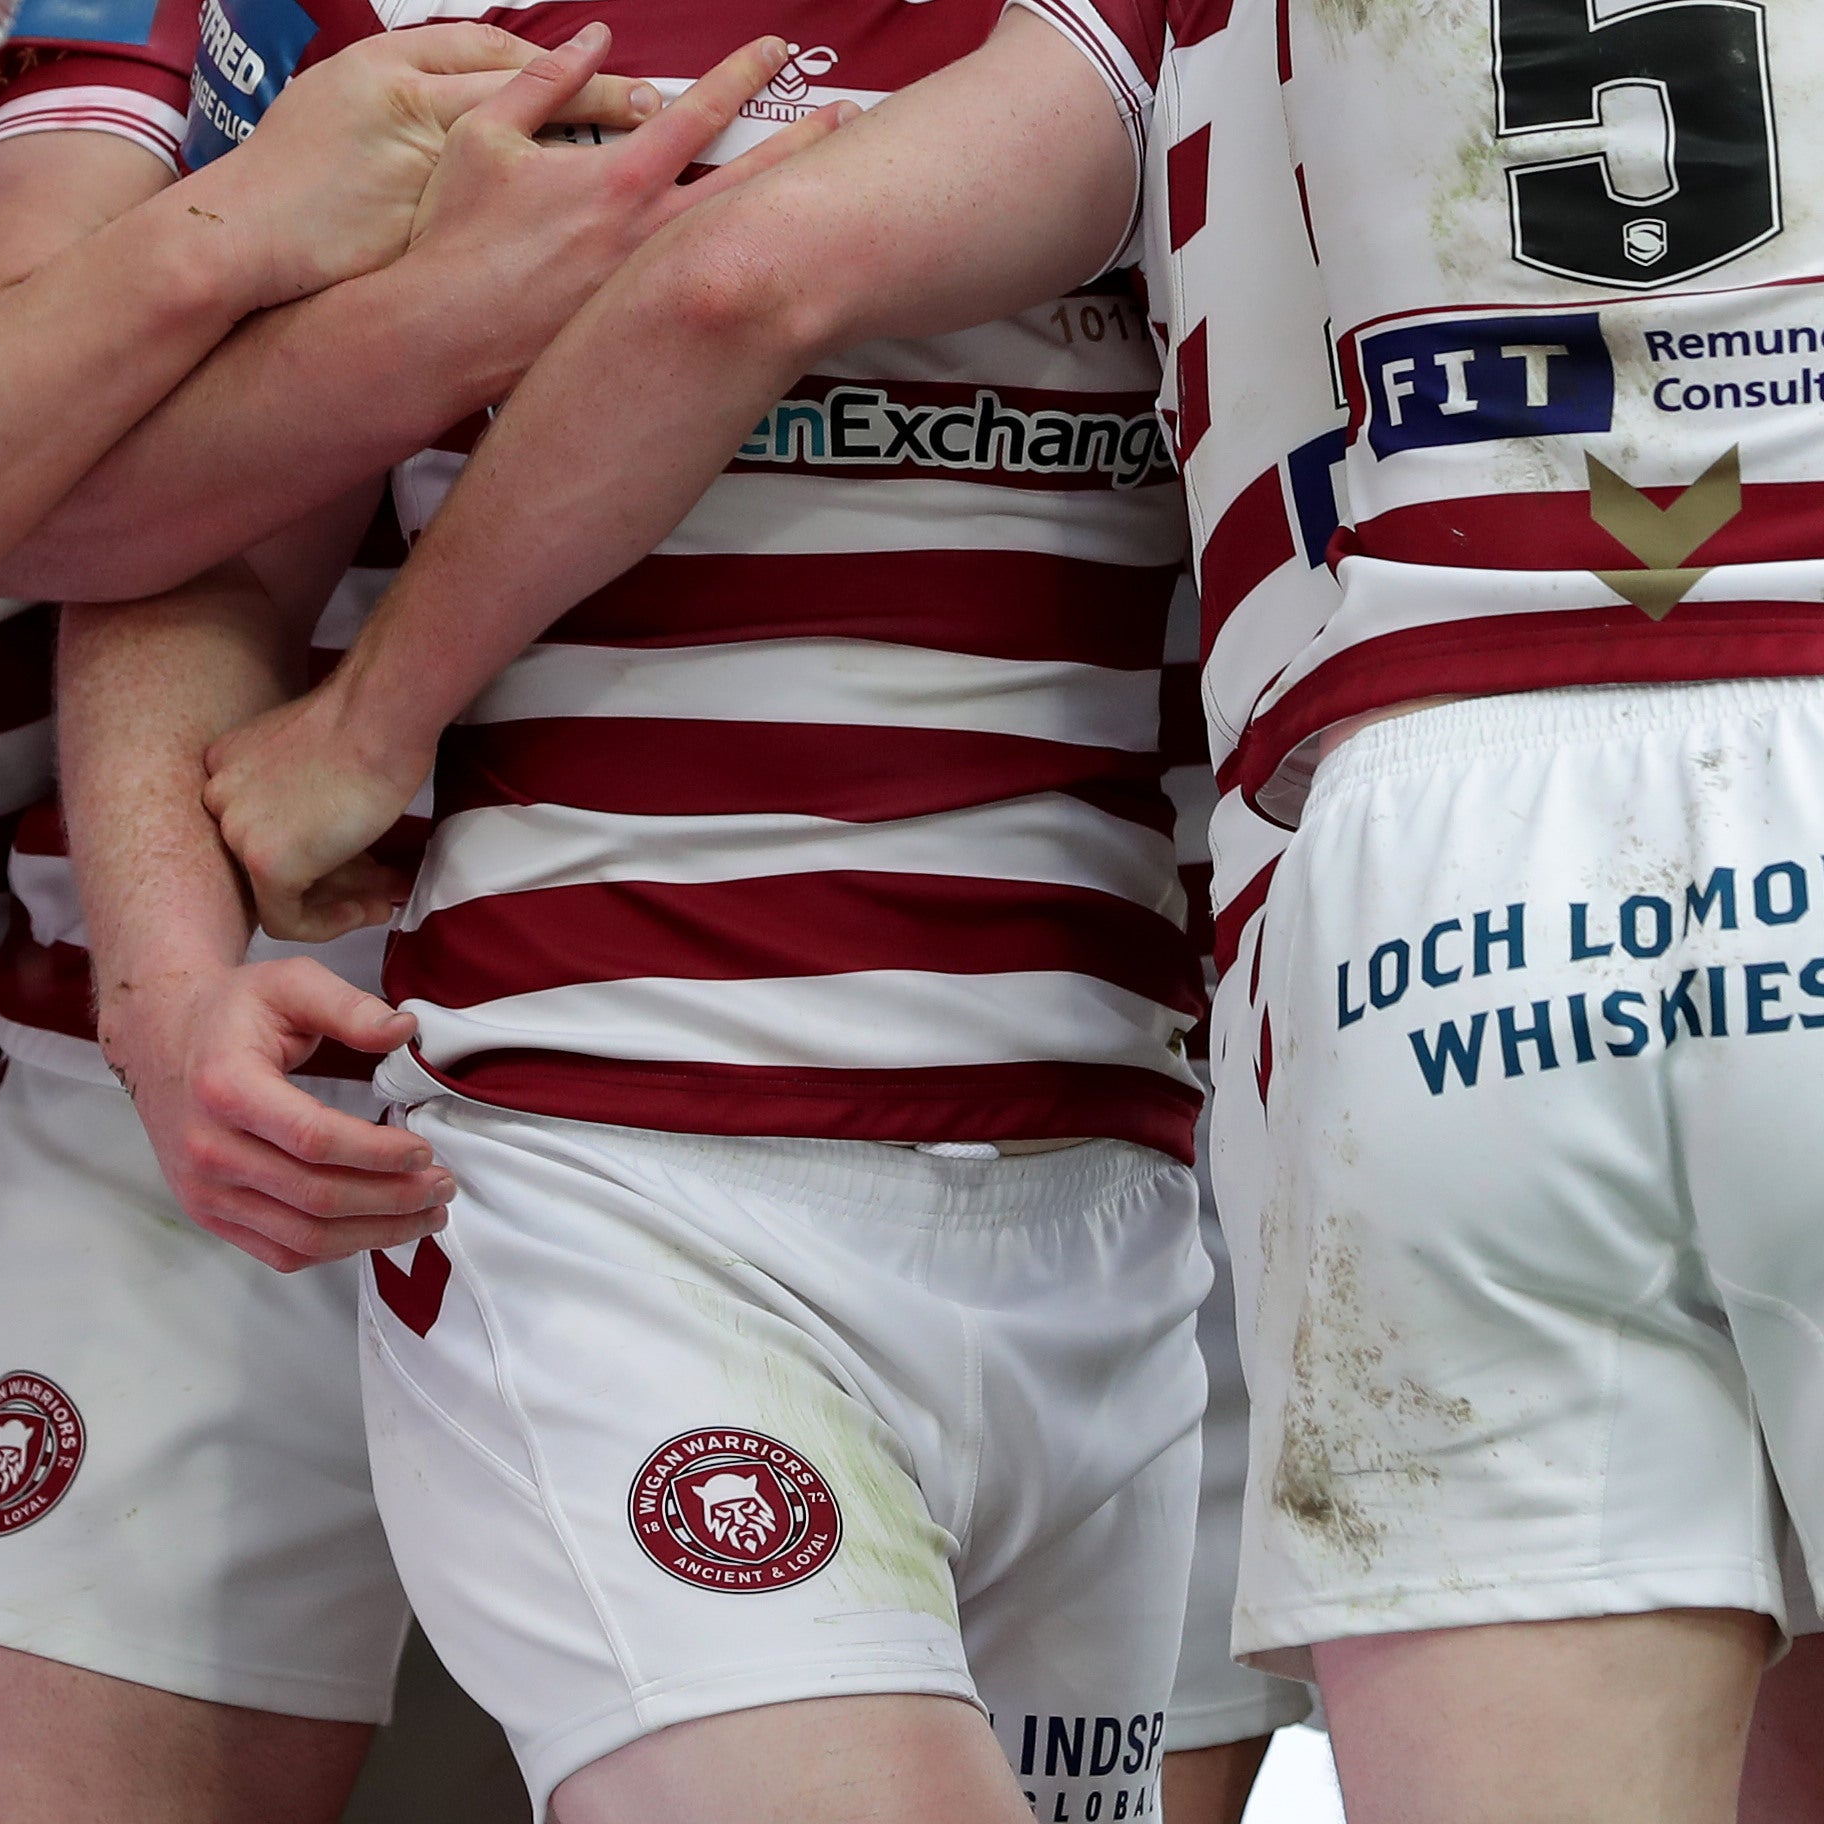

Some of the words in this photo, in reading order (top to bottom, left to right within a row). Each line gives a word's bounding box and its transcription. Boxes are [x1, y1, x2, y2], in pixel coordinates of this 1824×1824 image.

[1381, 344, 1570, 427] FIT
[1337, 902, 1525, 1031] LOCH
[8, 1379, 77, 1450] WARRIORS
[639, 1450, 684, 1515] WIGAN
[682, 1435, 814, 1486] WARRIORS
[808, 1492, 828, 1503] 72
[4, 1494, 49, 1526] LOYAL
[643, 1521, 661, 1534] 18
[673, 1556, 763, 1584] ANCIENT
[772, 1567, 785, 1578] &
[787, 1531, 828, 1572] LOYAL
[989, 1711, 1164, 1777] INDSP
